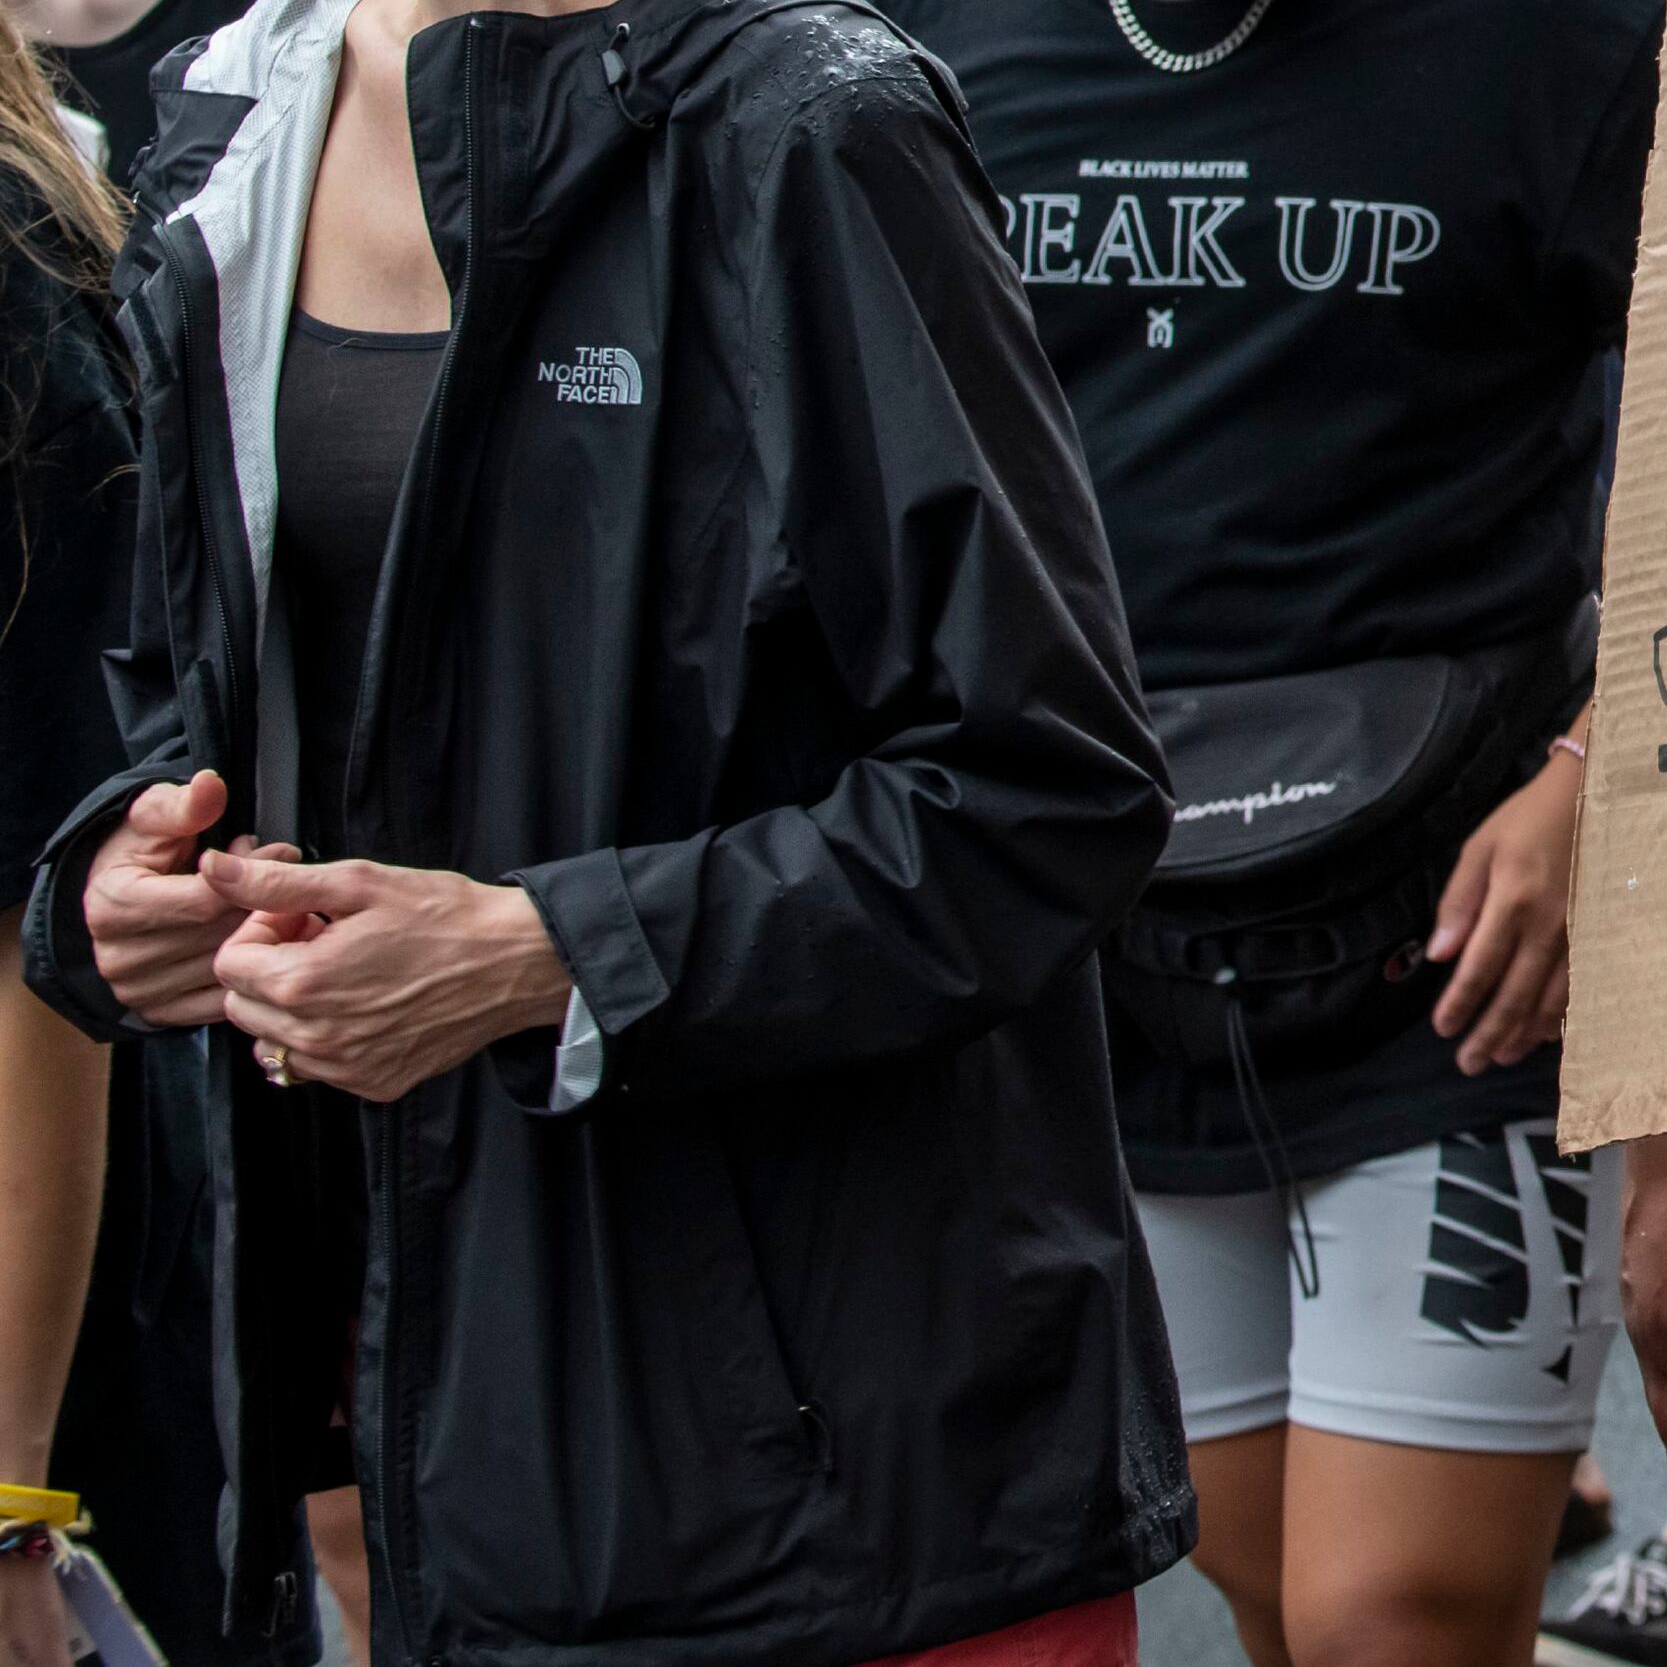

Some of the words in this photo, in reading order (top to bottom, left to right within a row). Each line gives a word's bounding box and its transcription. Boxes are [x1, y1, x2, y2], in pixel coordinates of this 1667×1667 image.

[1079, 159, 1132, 177] BLACK
[1134, 160, 1180, 178] LIVES
[1181, 160, 1248, 178] MATTER
[1000, 193, 1247, 287] EAK
[1274, 197, 1441, 295] UP
[575, 346, 615, 365] THE
[537, 361, 612, 385] NORTH
[557, 383, 609, 404] FACE
[1172, 780, 1338, 825] ampion
